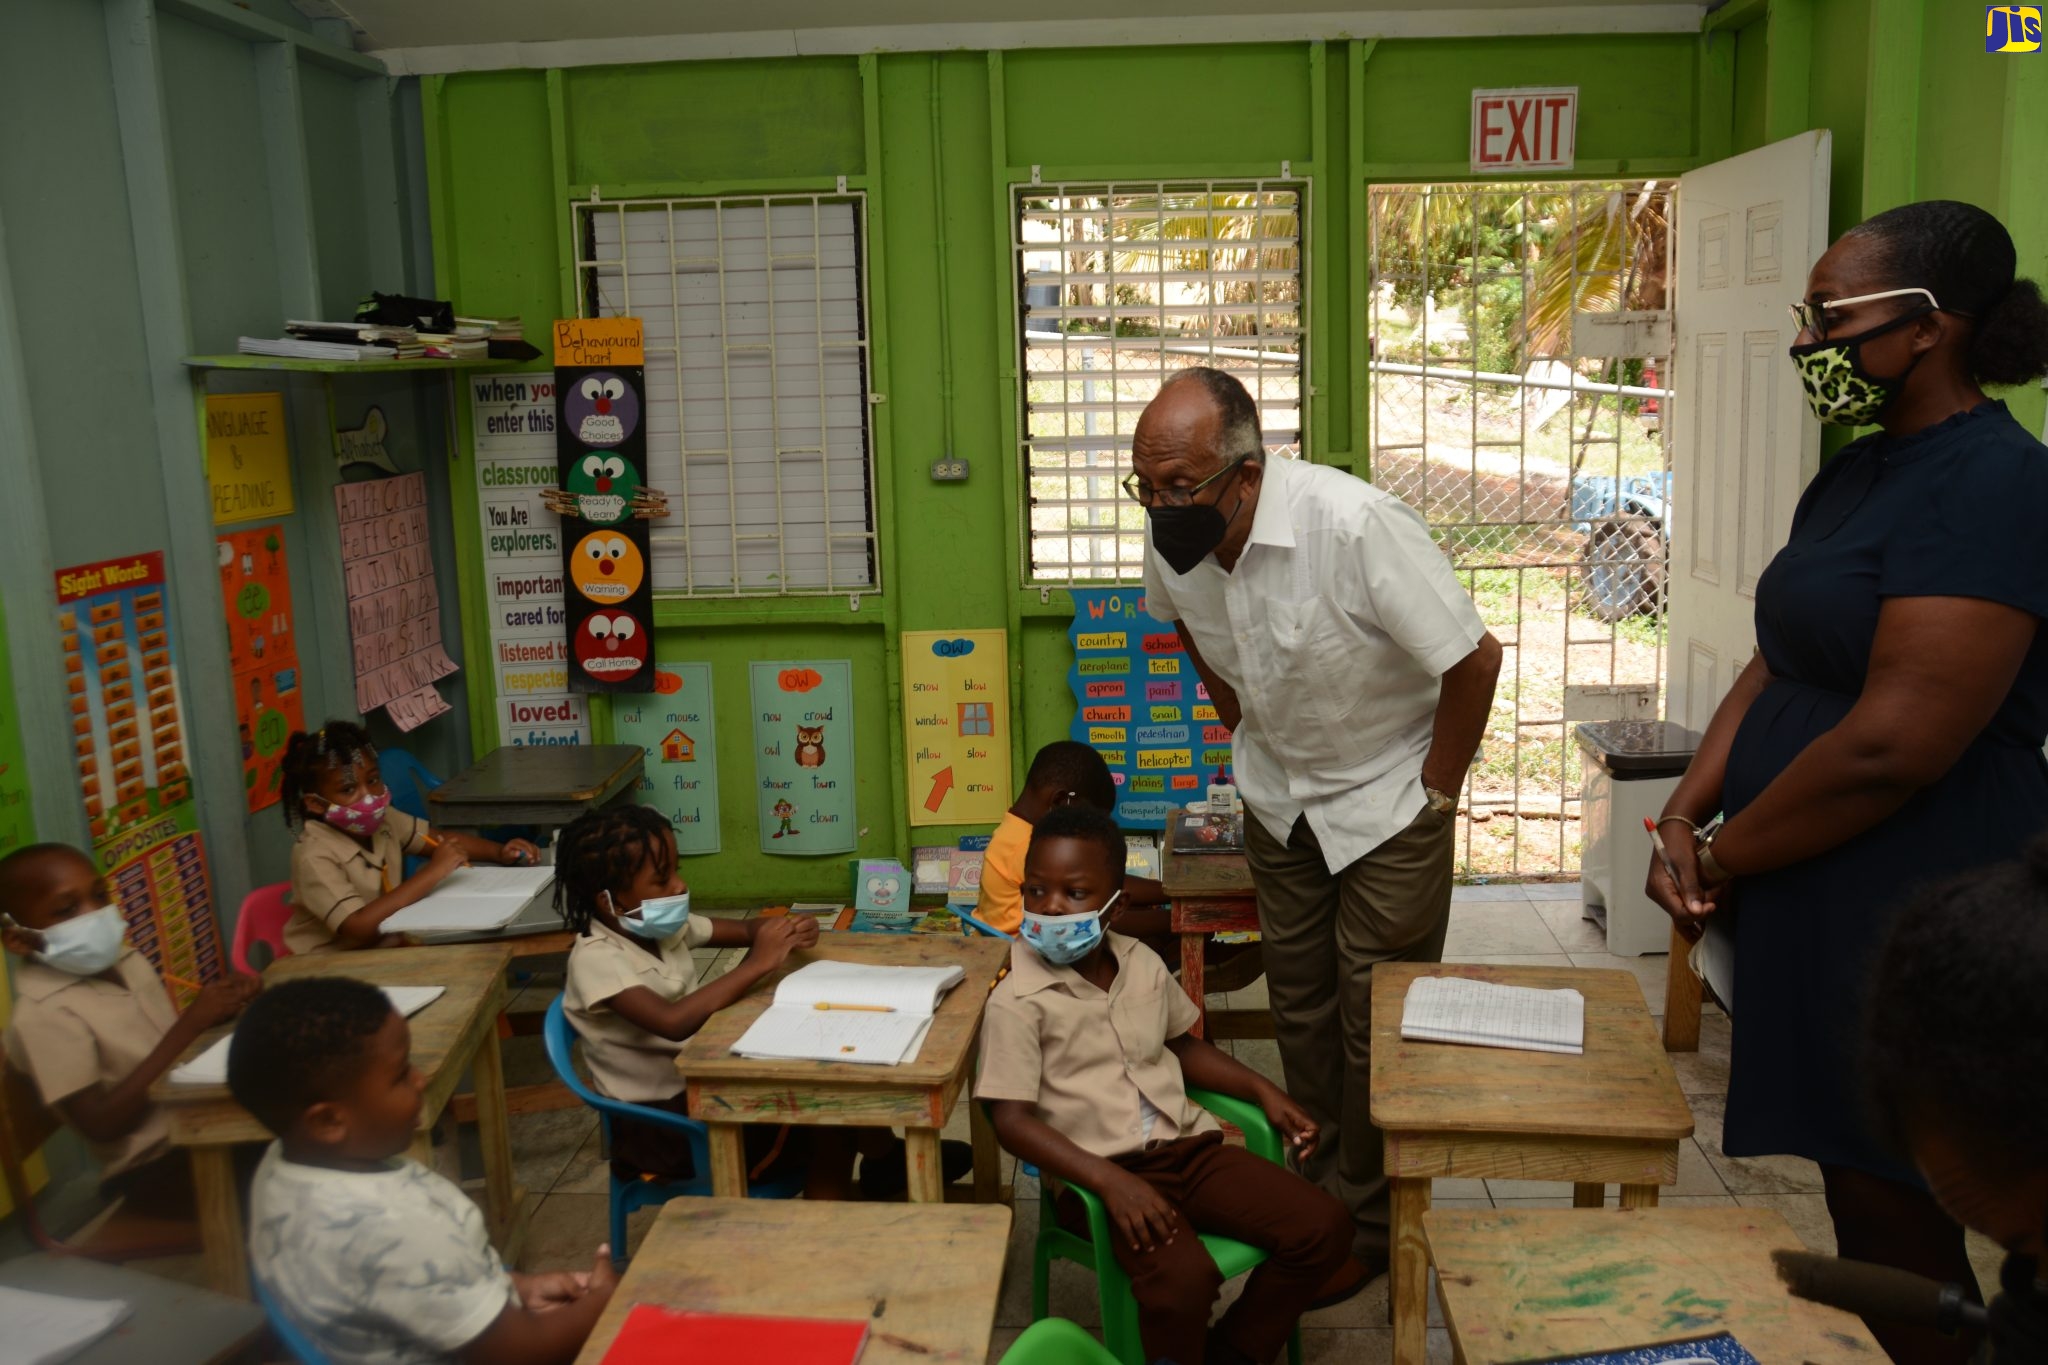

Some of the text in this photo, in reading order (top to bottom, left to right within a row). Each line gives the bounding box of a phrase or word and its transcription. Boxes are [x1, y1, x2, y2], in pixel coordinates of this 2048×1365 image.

[1480, 98, 1568, 162] EXIT
[558, 323, 640, 348] Behavioural
[573, 347, 612, 365] Chart
[475, 378, 526, 402] when
[487, 409, 554, 434] enter this
[586, 417, 615, 427] Good
[581, 430, 621, 440] Choices
[213, 480, 275, 513] READING
[580, 496, 612, 508] Ready
[613, 497, 624, 506] to
[488, 506, 528, 527] You Are
[589, 510, 616, 519] Learn
[490, 529, 557, 557] explorers.
[59, 560, 149, 597] Sight Words
[496, 575, 565, 600] importan
[585, 584, 626, 595] Warning
[506, 607, 543, 627] cared
[1079, 634, 1181, 650] country school
[499, 641, 553, 663] listened
[587, 657, 638, 669] Call Home
[1079, 660, 1177, 673] aeroplane teeth
[913, 678, 987, 692] snow blow
[1088, 682, 1177, 699] apron paint
[510, 700, 578, 723] loved.
[623, 706, 700, 724] out mouse
[763, 707, 833, 723] now crowd
[1086, 707, 1126, 721] church
[1152, 710, 1177, 720] snail
[915, 714, 949, 726] window
[1090, 731, 1125, 741] smooth
[1137, 728, 1185, 742] pedestrian
[765, 740, 781, 756] owl
[916, 747, 987, 764] pillow slow
[1139, 753, 1190, 768] helicopter
[674, 775, 700, 791] flour
[763, 775, 836, 790] shower town
[966, 781, 994, 793] arrow
[1132, 774, 1163, 790] plains
[673, 809, 700, 824] cloud
[810, 809, 839, 824] clown
[103, 816, 178, 869] OPPOSITES
